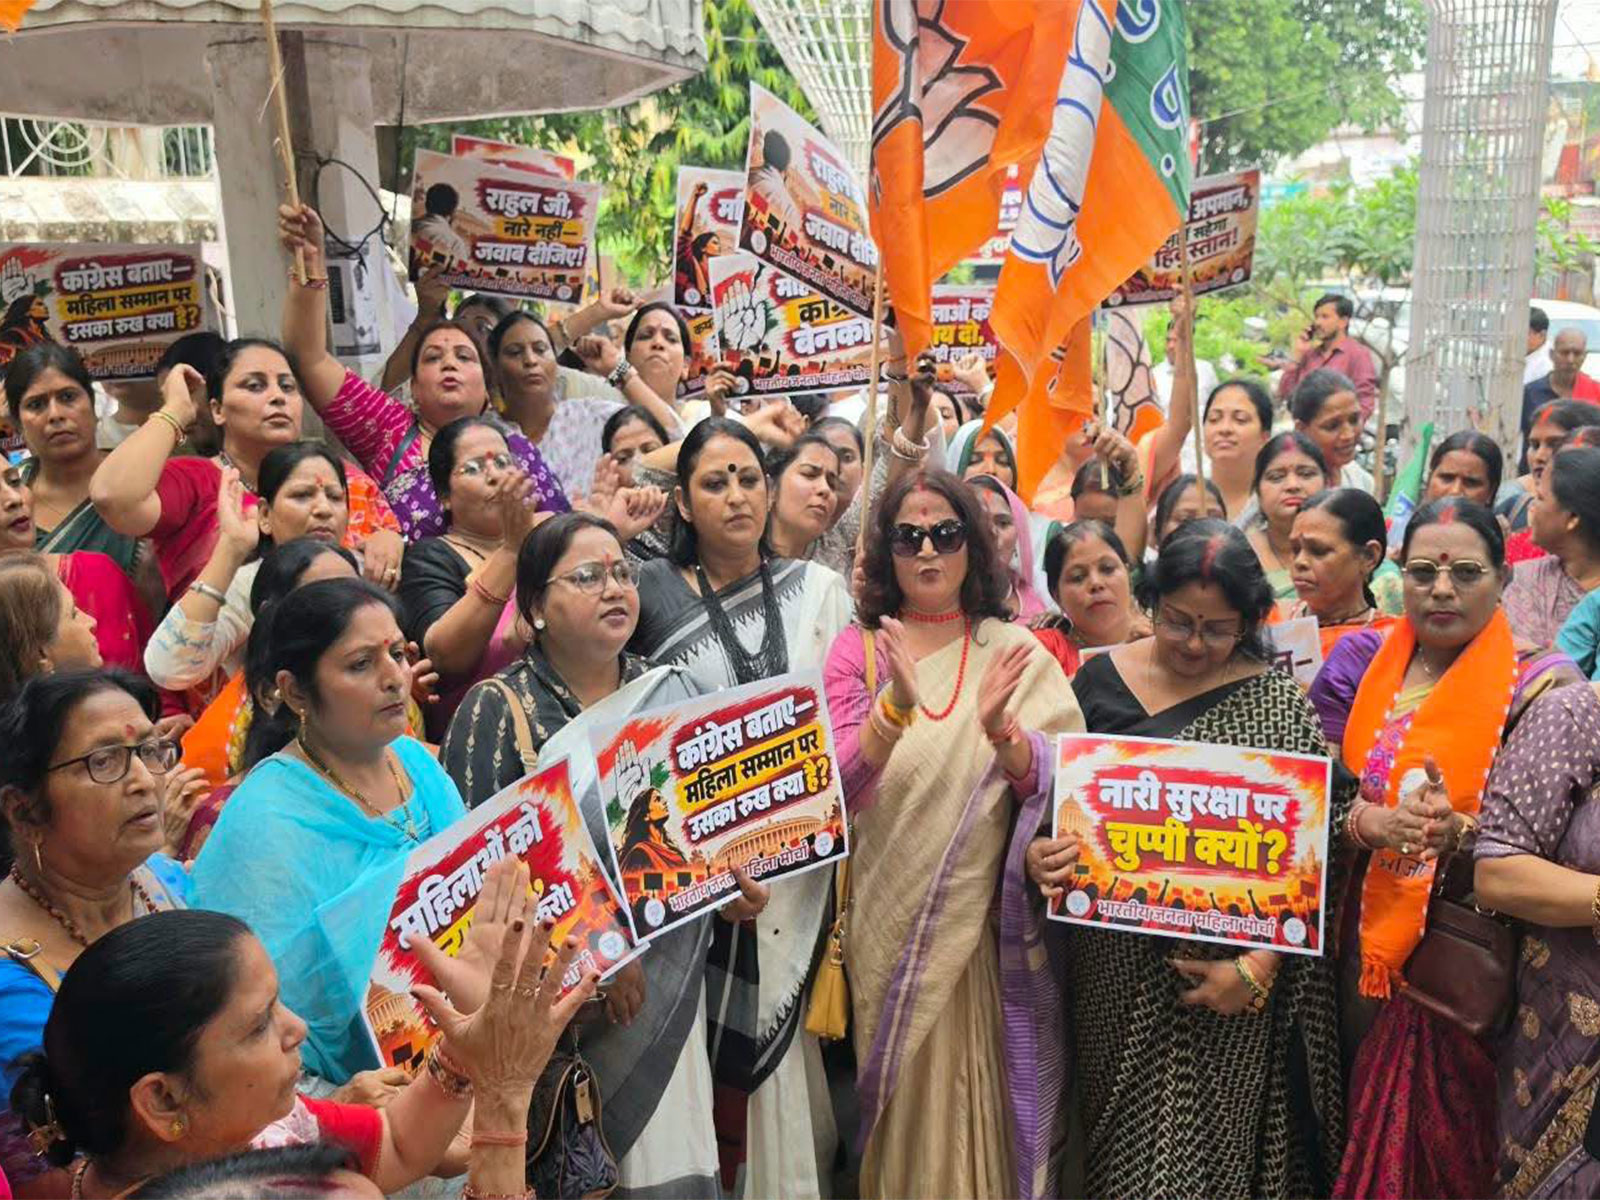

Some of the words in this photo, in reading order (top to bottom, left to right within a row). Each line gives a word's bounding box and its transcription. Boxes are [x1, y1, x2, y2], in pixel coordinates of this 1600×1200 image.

[485, 188, 542, 219] राहुल
[542, 192, 573, 219] जी,
[1190, 187, 1251, 220] अपमान,
[504, 218, 532, 236] नारे
[474, 241, 527, 262] जवाब
[527, 242, 585, 268] दीजिए!
[61, 262, 124, 291] कांग्रेस
[66, 293, 116, 315] महिला
[120, 291, 169, 309] सम्मान
[172, 287, 192, 302] पर
[67, 319, 114, 341] उसका
[115, 316, 144, 336] रुख
[146, 312, 175, 329] क्या
[175, 306, 199, 331] है?
[792, 319, 873, 355] बेनका
[676, 726, 743, 771] कांग्रेस
[684, 767, 737, 803] महिला
[741, 742, 796, 780] सम्मान
[798, 731, 820, 755] पर
[688, 803, 737, 841] उसका
[737, 795, 771, 818] रुख
[772, 771, 805, 802] क्या
[803, 756, 831, 794] है?
[1098, 770, 1163, 811] नारी
[1164, 782, 1251, 822] सुरक्षा
[1251, 792, 1291, 823] पर
[1105, 817, 1190, 871] चुप्पी
[1193, 818, 1288, 875] क्यों?
[391, 824, 506, 951] महिलाओं
[505, 801, 543, 855] को
[668, 879, 711, 912] भारतीय
[1097, 899, 1150, 921] भारतीय
[1149, 906, 1193, 926] जनता
[1194, 911, 1244, 933] महिला
[1241, 915, 1276, 938] मोर्चा
